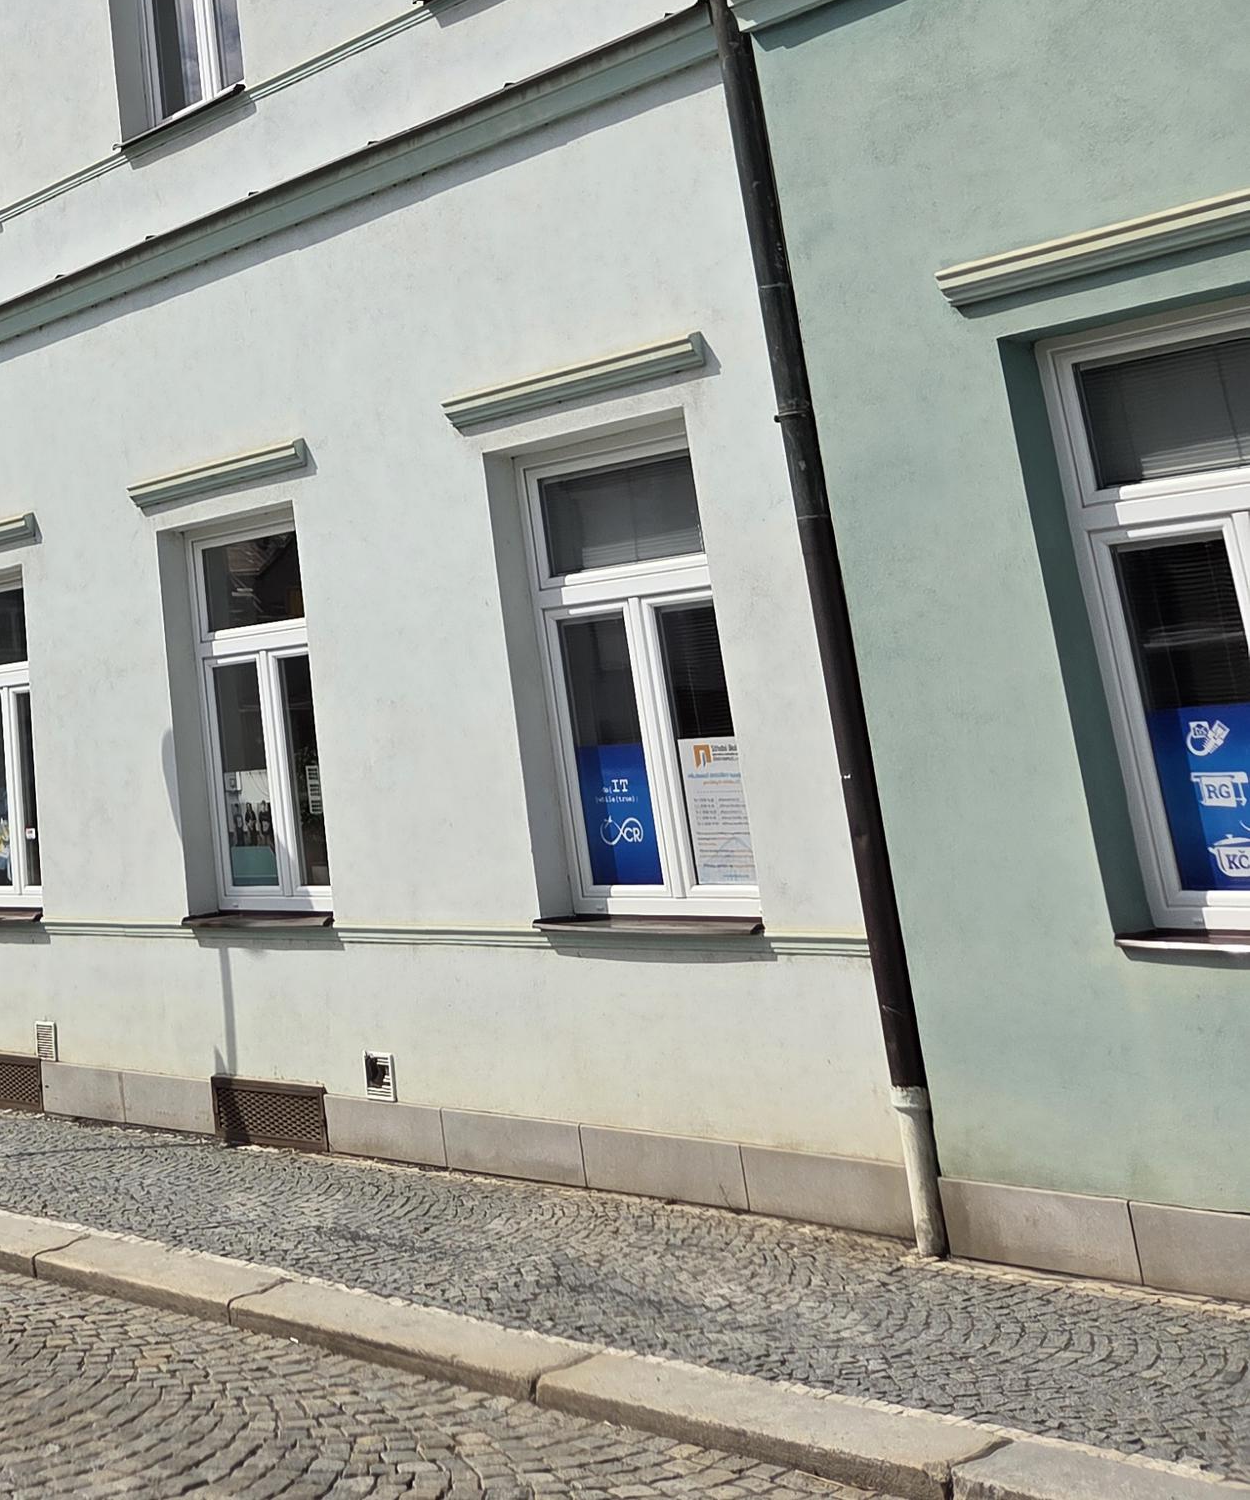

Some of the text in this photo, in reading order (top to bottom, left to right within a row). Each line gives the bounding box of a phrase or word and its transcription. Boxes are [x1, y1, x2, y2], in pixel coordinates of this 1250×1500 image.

[611, 778, 629, 793] IT
[1205, 783, 1231, 799] RG
[623, 827, 642, 843] CR
[1225, 849, 1250, 870] KČ
